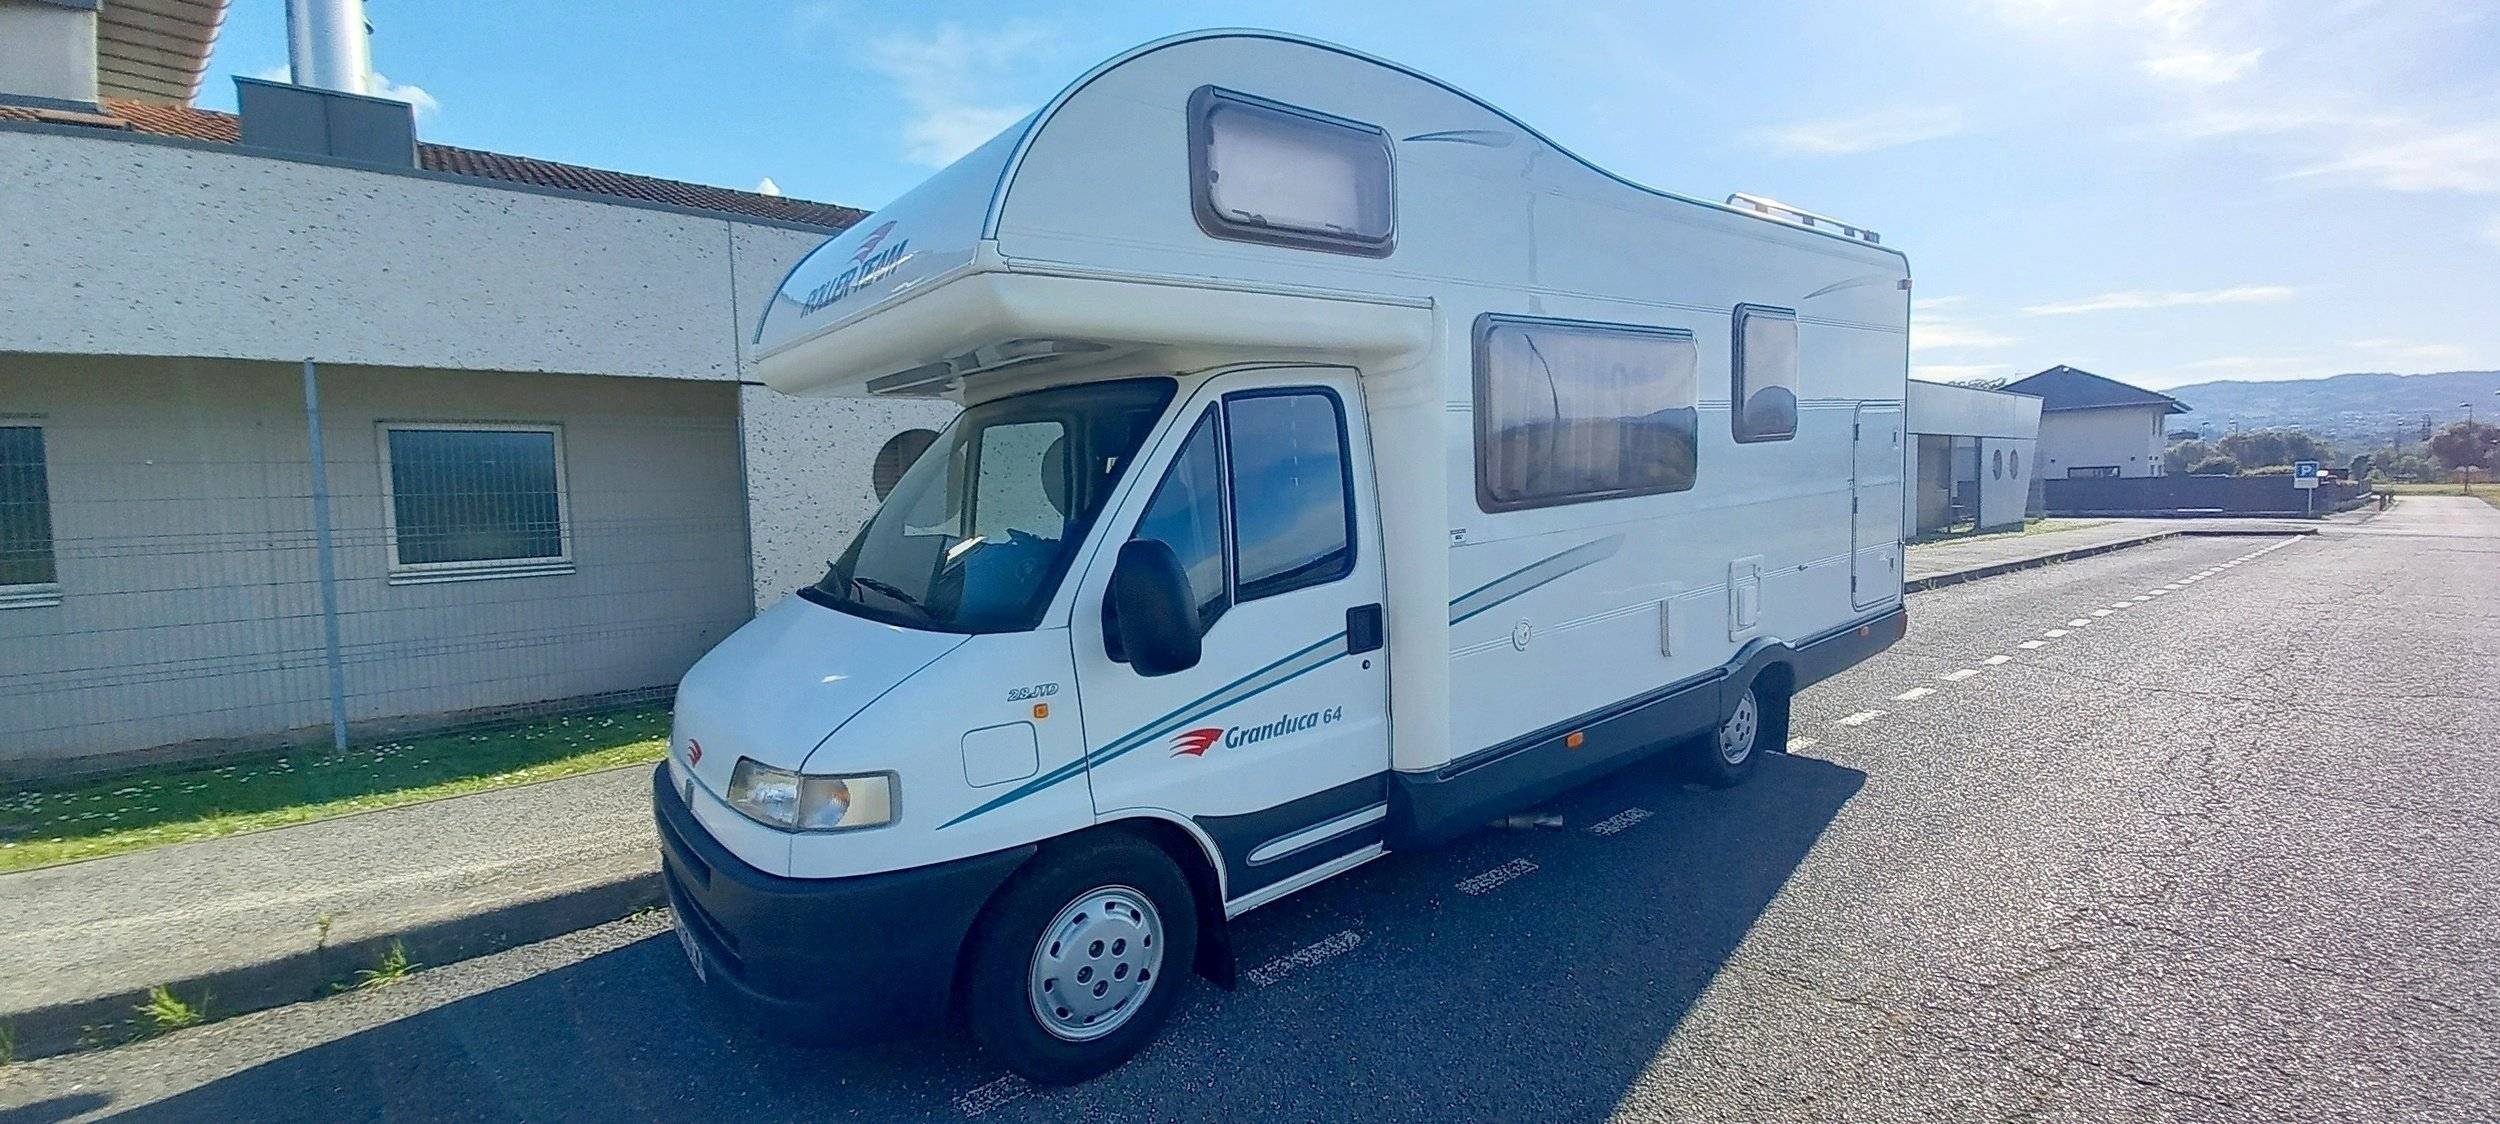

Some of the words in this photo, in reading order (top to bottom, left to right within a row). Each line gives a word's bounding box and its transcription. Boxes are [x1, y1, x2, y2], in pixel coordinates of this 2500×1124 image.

[801, 266, 858, 318] ROLLER
[854, 239, 909, 293] TEAM
[1225, 712, 1319, 749] Granduca
[1323, 706, 1342, 724] 64
